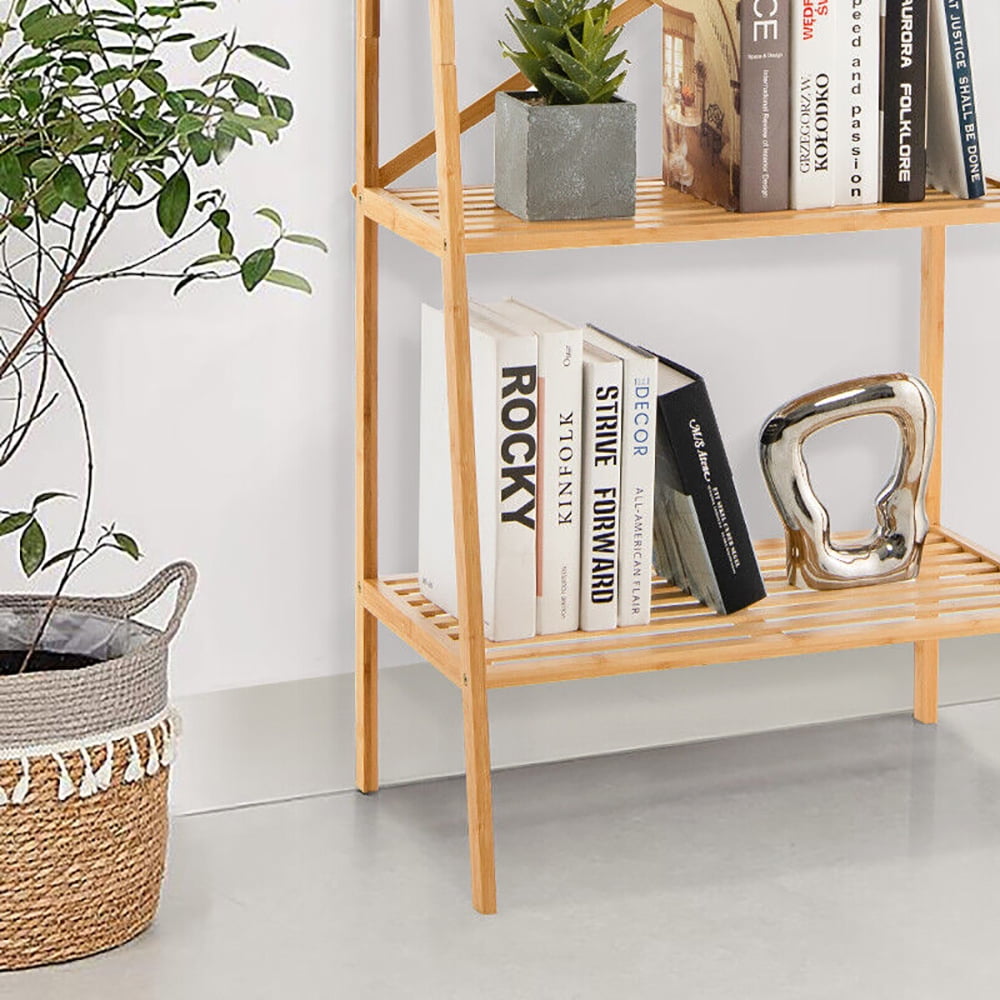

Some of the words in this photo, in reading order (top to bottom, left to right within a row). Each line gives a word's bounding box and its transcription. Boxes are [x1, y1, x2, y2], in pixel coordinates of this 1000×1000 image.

[851, 57, 862, 96] and
[951, 14, 967, 69] JUSTICE
[761, 113, 769, 138] Review
[814, 73, 829, 172] KOŁODKO
[898, 82, 912, 182] FOLKLORE
[959, 76, 975, 120] SHALL
[965, 123, 976, 142] BE
[760, 174, 769, 199] Design
[850, 105, 862, 198] passion
[967, 145, 982, 183] DONE
[501, 364, 537, 531] ROCKY
[594, 386, 618, 467] STRIVE
[633, 385, 650, 457] DECOR
[558, 411, 574, 525] KINFOLK
[591, 486, 617, 605] FORWARD
[633, 487, 644, 577] ALL-AMERICAN
[631, 580, 641, 616] FLAIR
